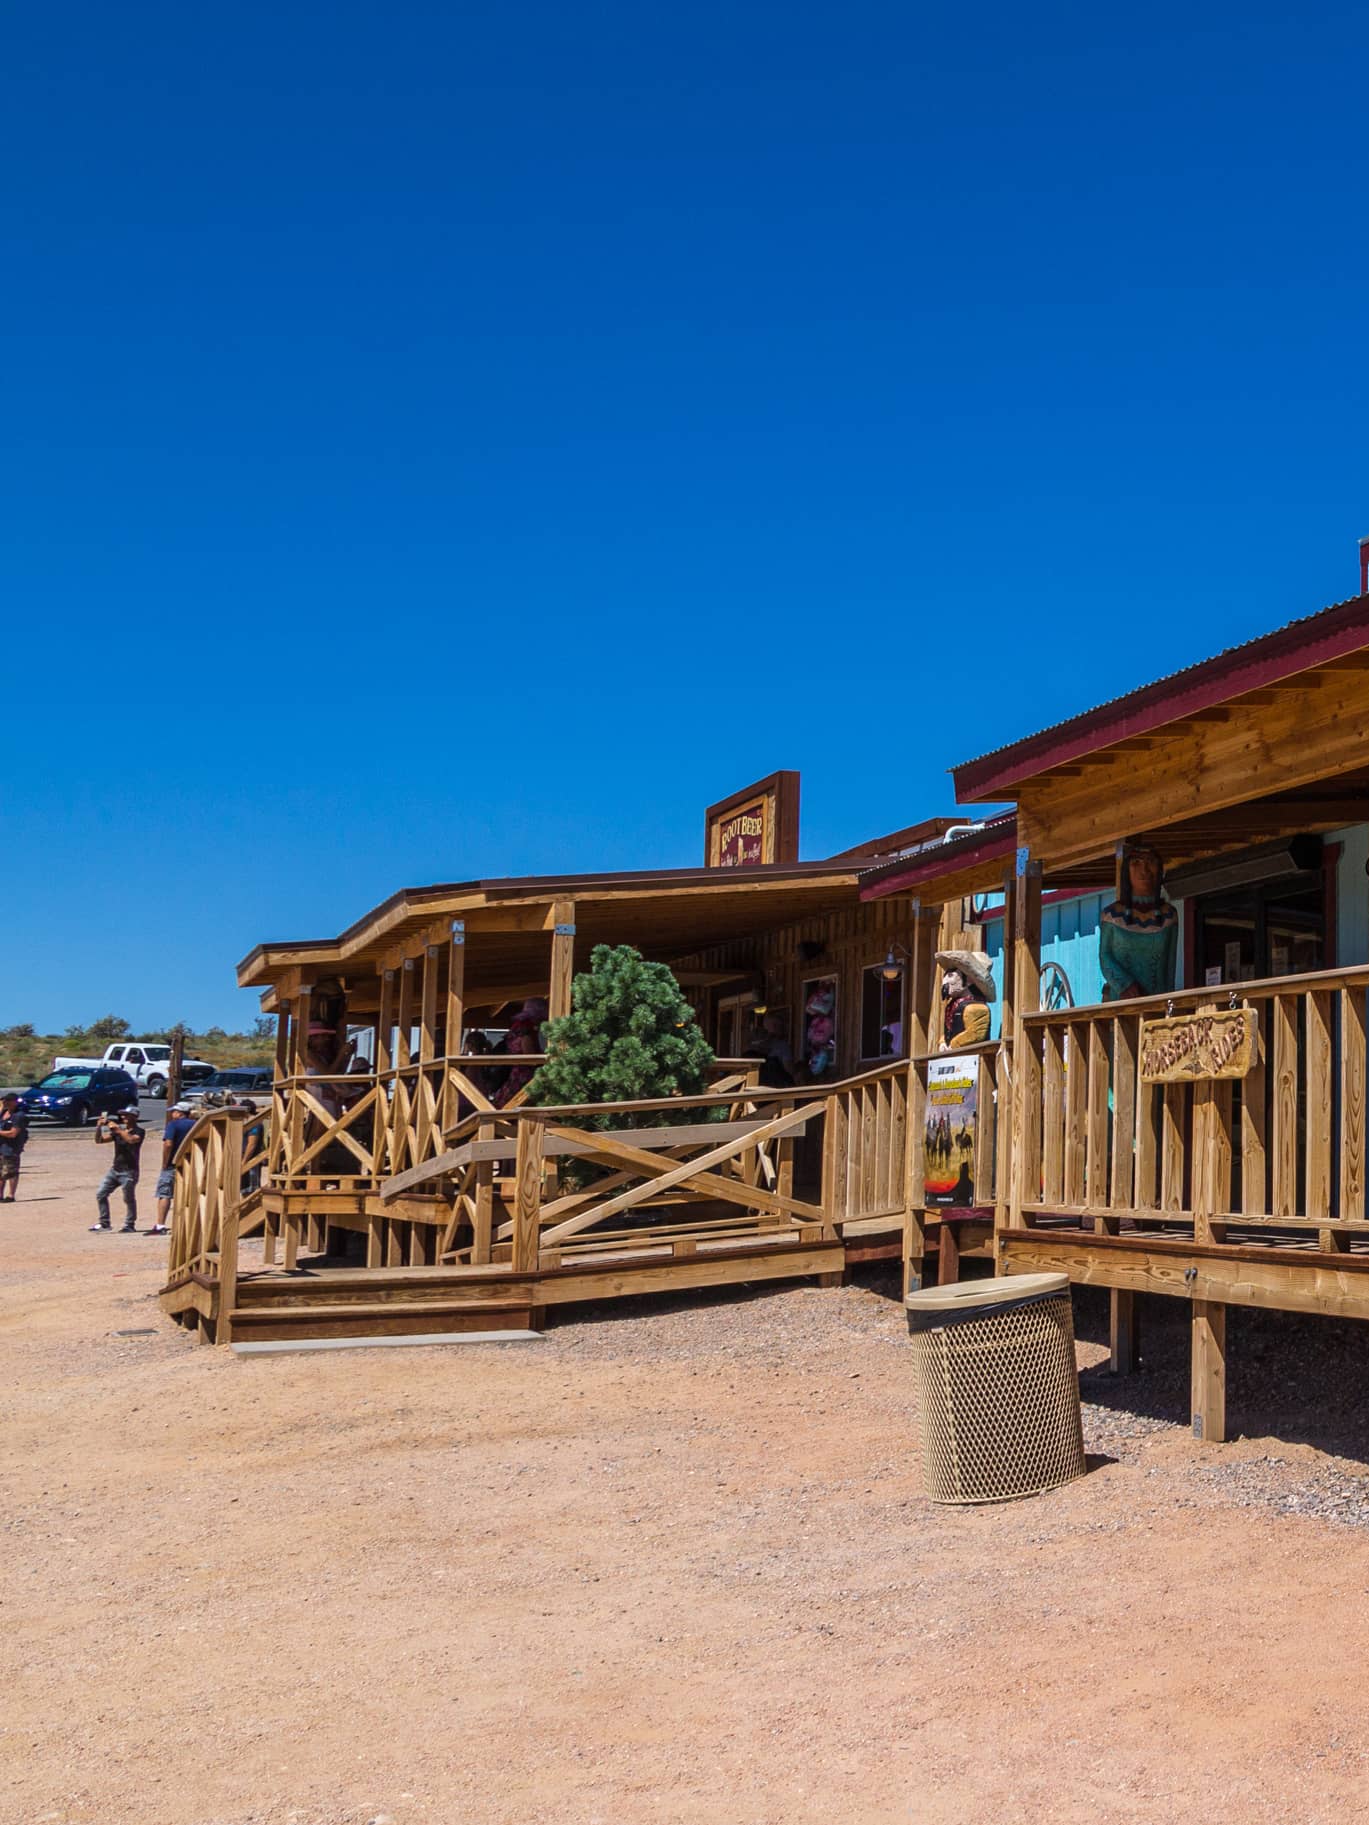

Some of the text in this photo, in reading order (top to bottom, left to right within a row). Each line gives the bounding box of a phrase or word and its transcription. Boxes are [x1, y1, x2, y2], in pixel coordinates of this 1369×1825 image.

[721, 816, 762, 853] ROOT BEER
[1142, 1017, 1245, 1077] HORSEBACK RIDES
